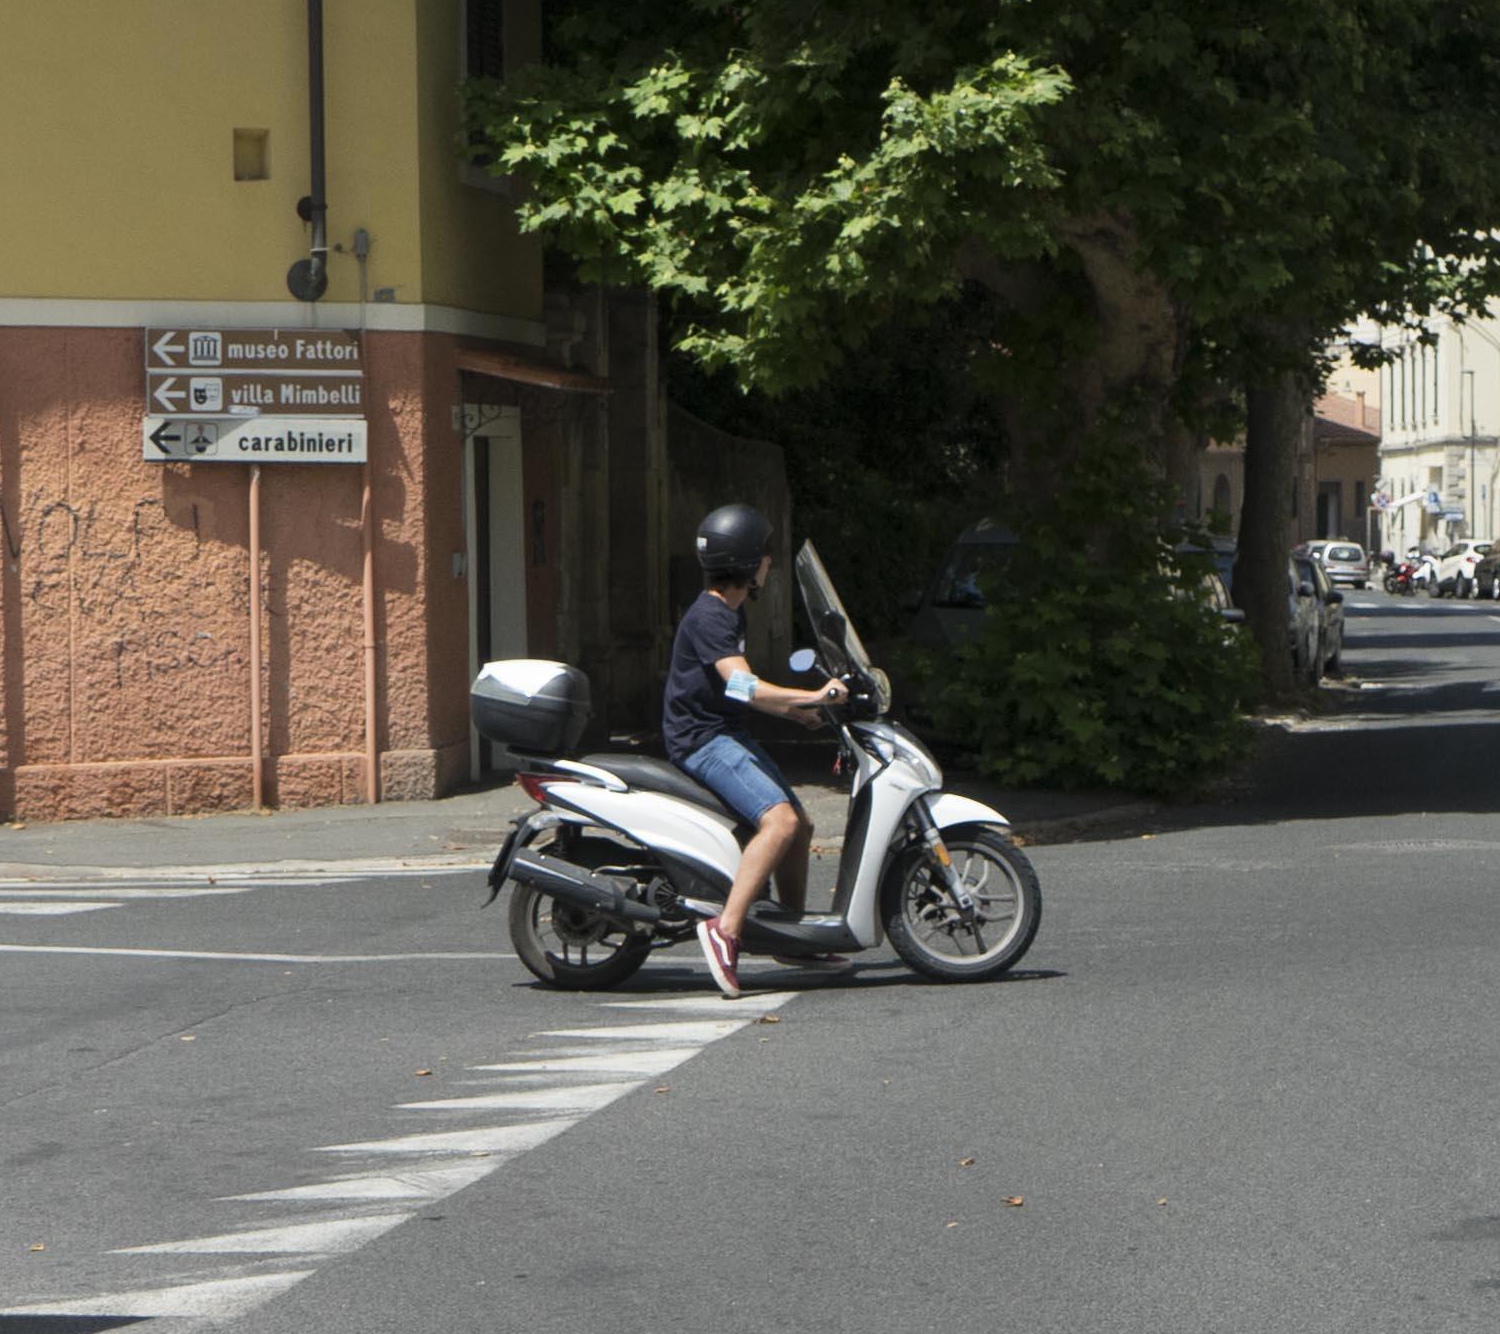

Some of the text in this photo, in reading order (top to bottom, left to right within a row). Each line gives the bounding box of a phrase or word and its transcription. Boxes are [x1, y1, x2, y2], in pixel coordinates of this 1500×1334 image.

[227, 339, 359, 359] museo Fattori
[231, 383, 361, 404] villa Mimbelli
[238, 430, 354, 453] carabinieri
